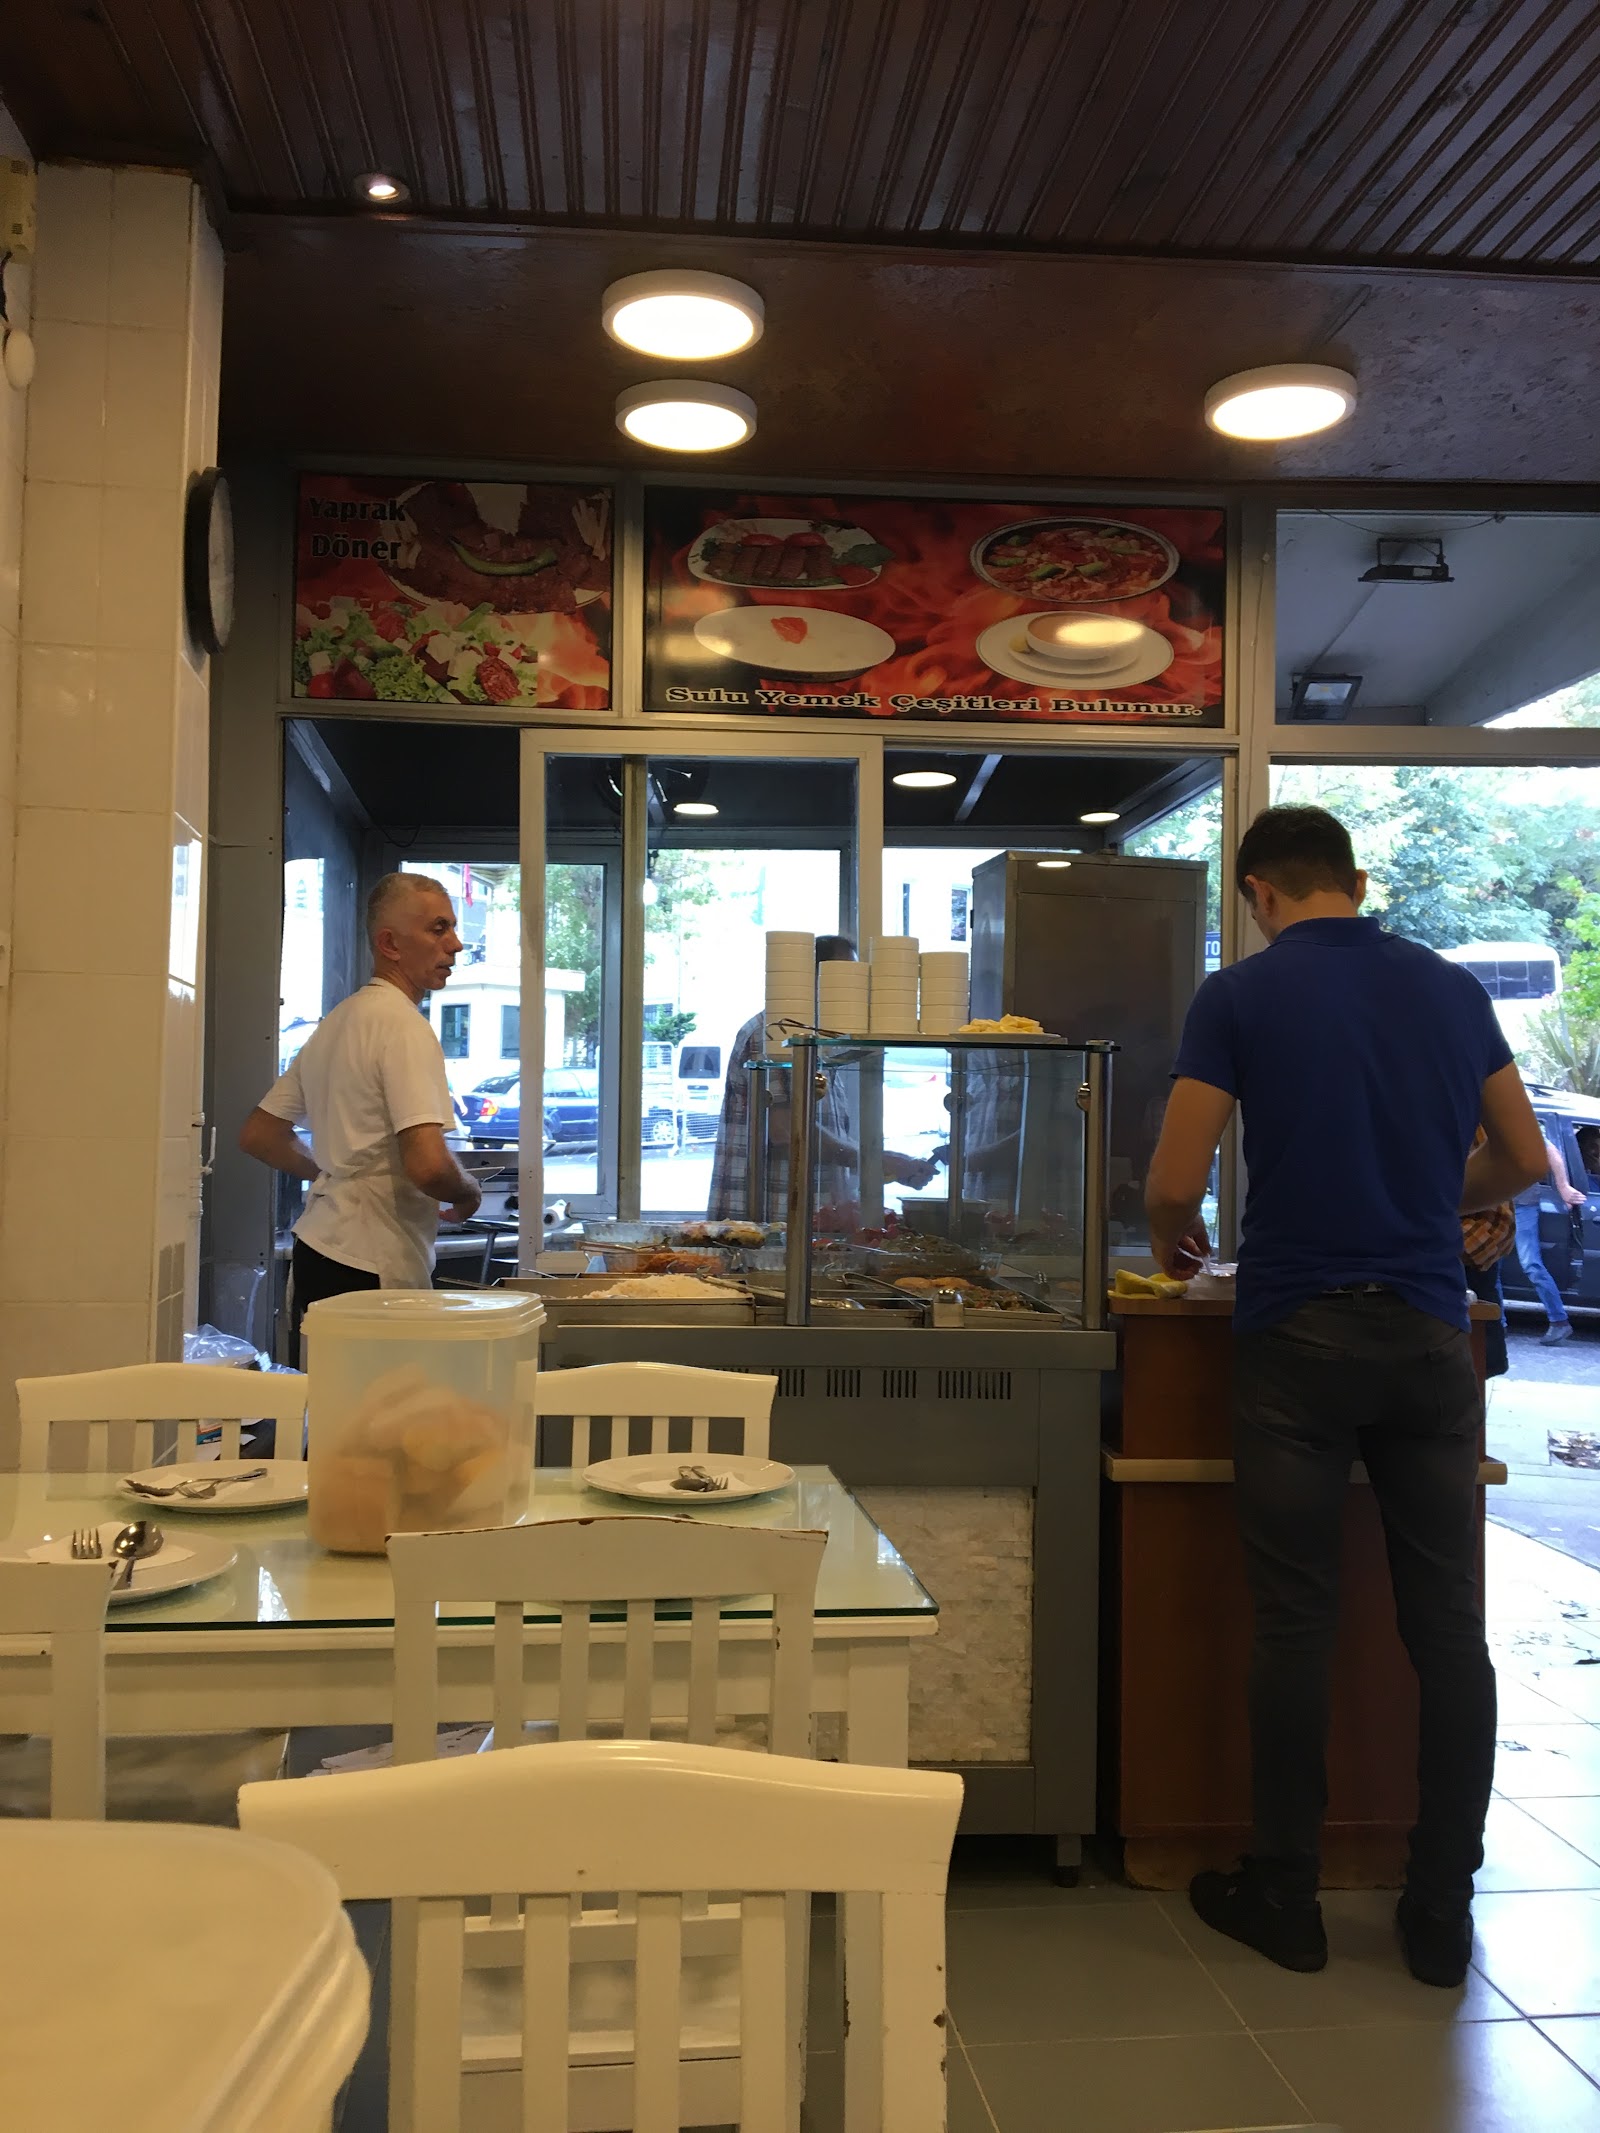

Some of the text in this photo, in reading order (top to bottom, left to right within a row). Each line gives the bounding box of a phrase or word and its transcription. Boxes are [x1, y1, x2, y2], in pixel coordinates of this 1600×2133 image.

[308, 497, 406, 523] Yaprak
[312, 532, 402, 560] Döner
[666, 686, 1203, 716] Sulu Yemek Çeşitleri Bulunur.
